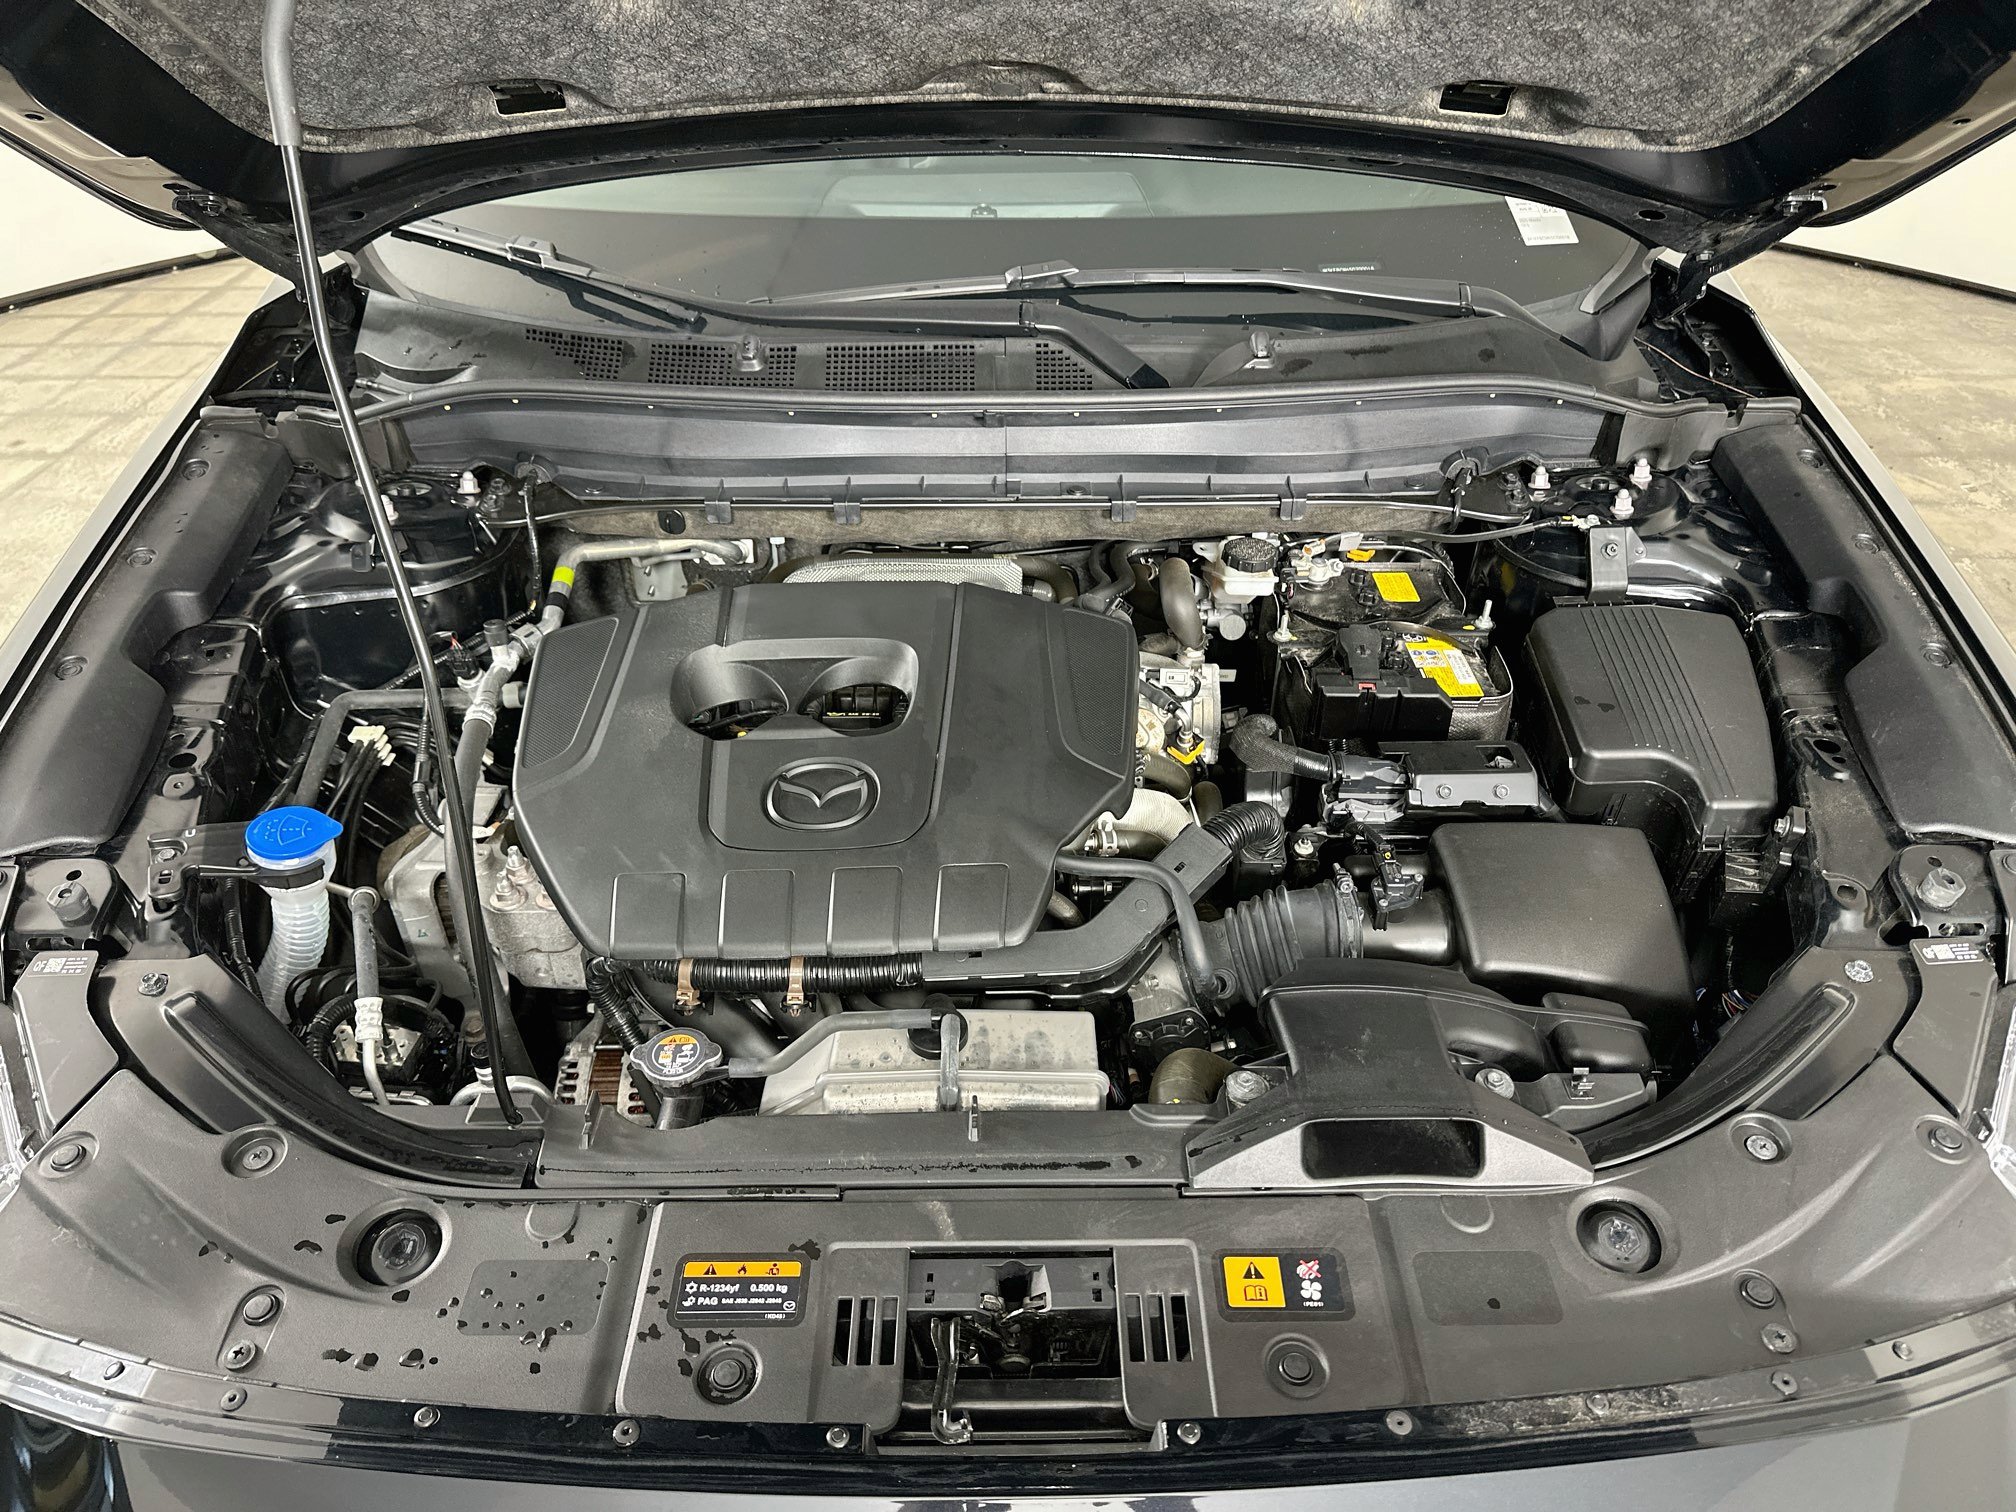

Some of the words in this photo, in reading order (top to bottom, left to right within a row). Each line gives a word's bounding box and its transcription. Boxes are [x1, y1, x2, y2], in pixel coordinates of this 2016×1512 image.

[699, 1284, 740, 1294] R-1234yf
[750, 1284, 774, 1292] 0.500
[776, 1284, 788, 1293] kg
[697, 1297, 719, 1305] PAG
